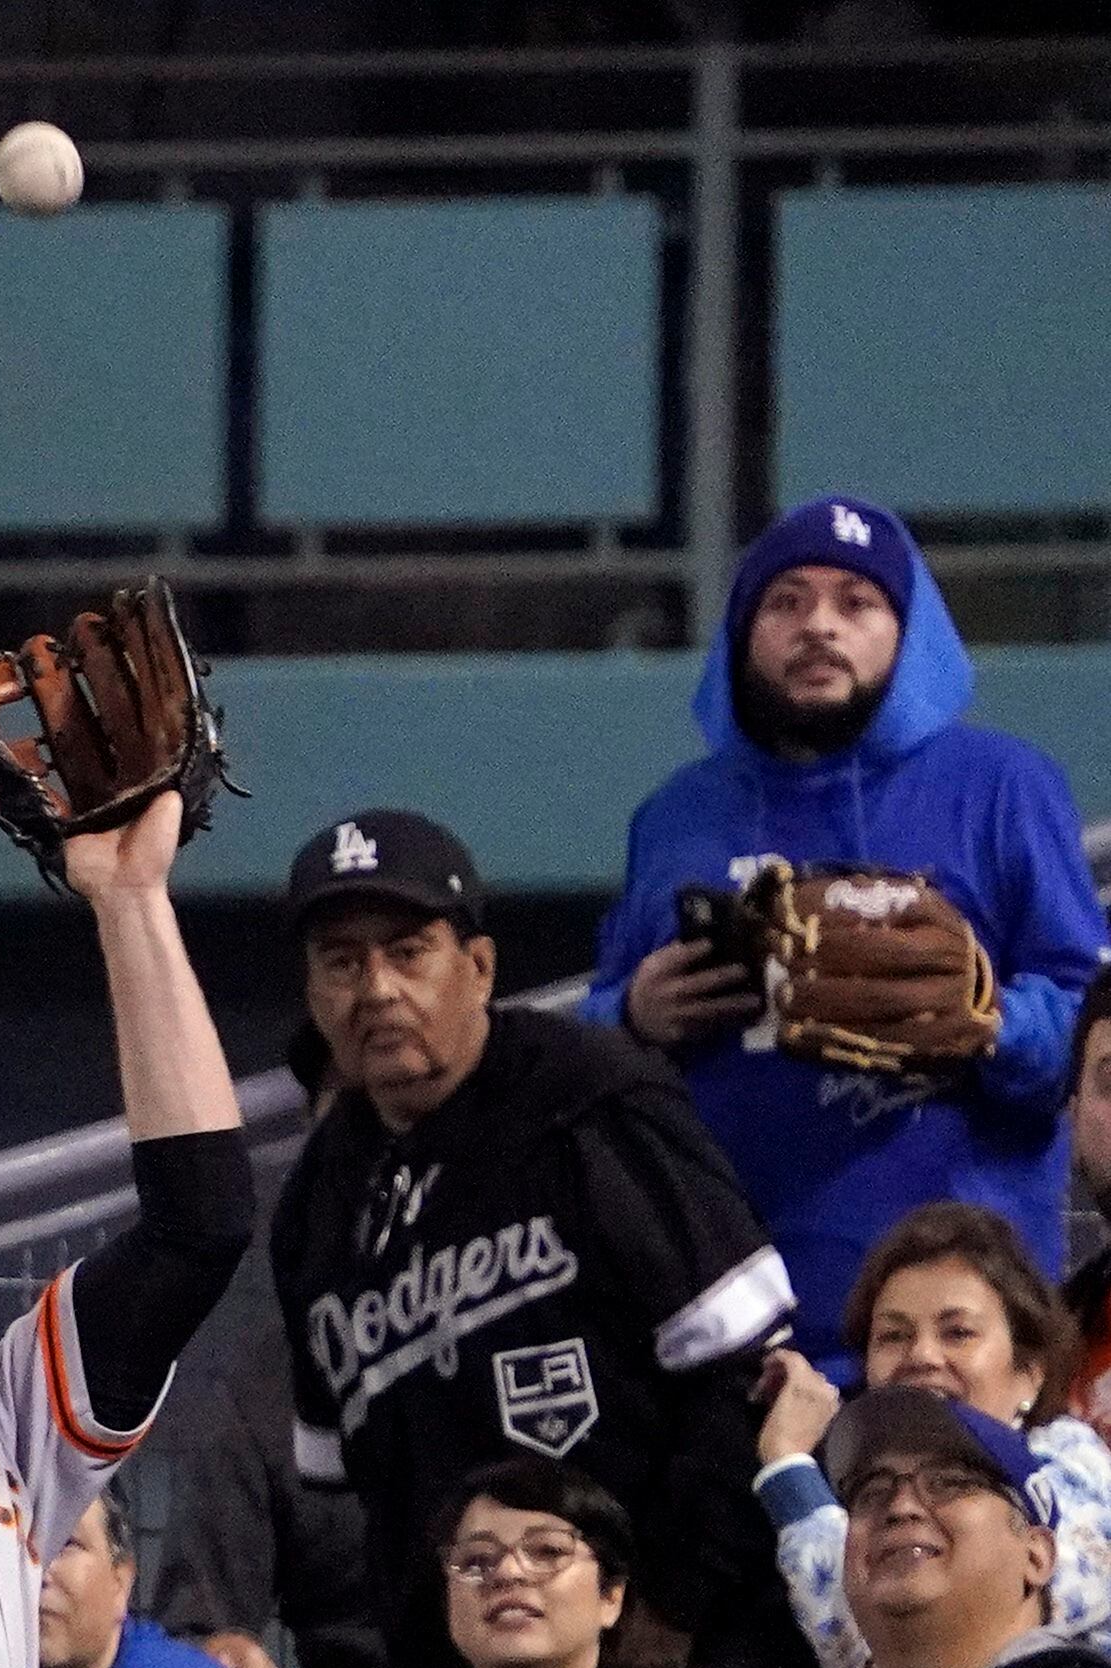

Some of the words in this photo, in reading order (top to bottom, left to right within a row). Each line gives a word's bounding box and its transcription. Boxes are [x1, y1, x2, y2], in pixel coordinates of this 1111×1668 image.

[831, 505, 872, 547] LA
[330, 822, 379, 873] LA
[307, 1214, 578, 1396] Dodgers
[504, 1353, 582, 1399] LA
